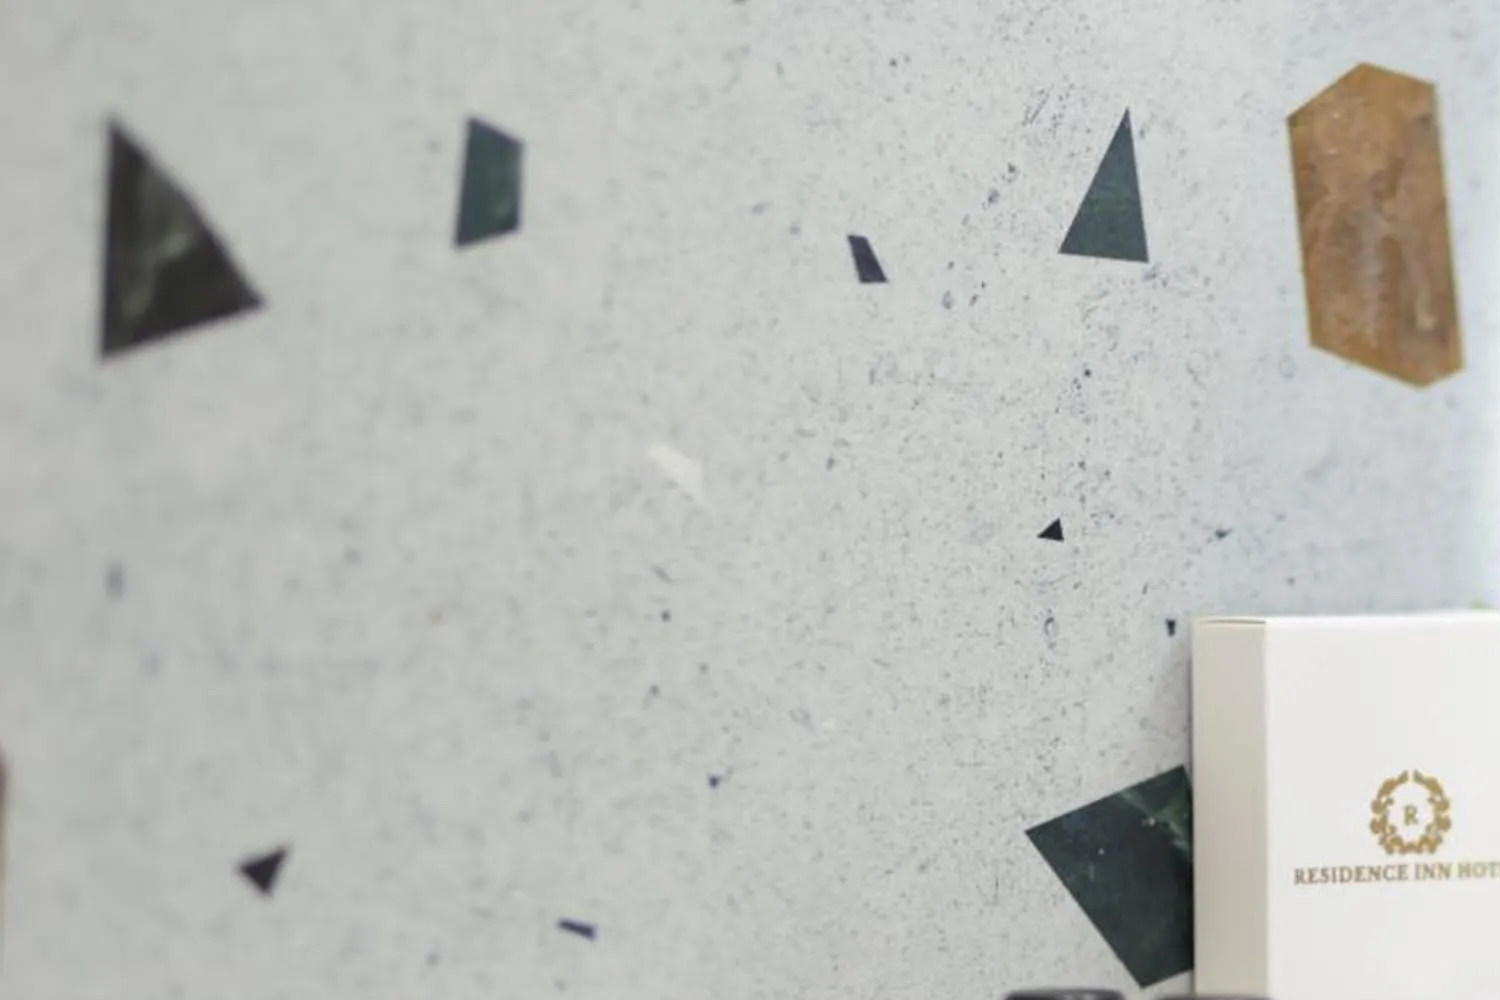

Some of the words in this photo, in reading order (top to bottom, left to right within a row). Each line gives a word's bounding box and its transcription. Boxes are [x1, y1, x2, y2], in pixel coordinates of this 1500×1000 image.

[1403, 804, 1419, 826] R
[1294, 864, 1409, 885] RESIDENCE
[1415, 862, 1450, 880] INN
